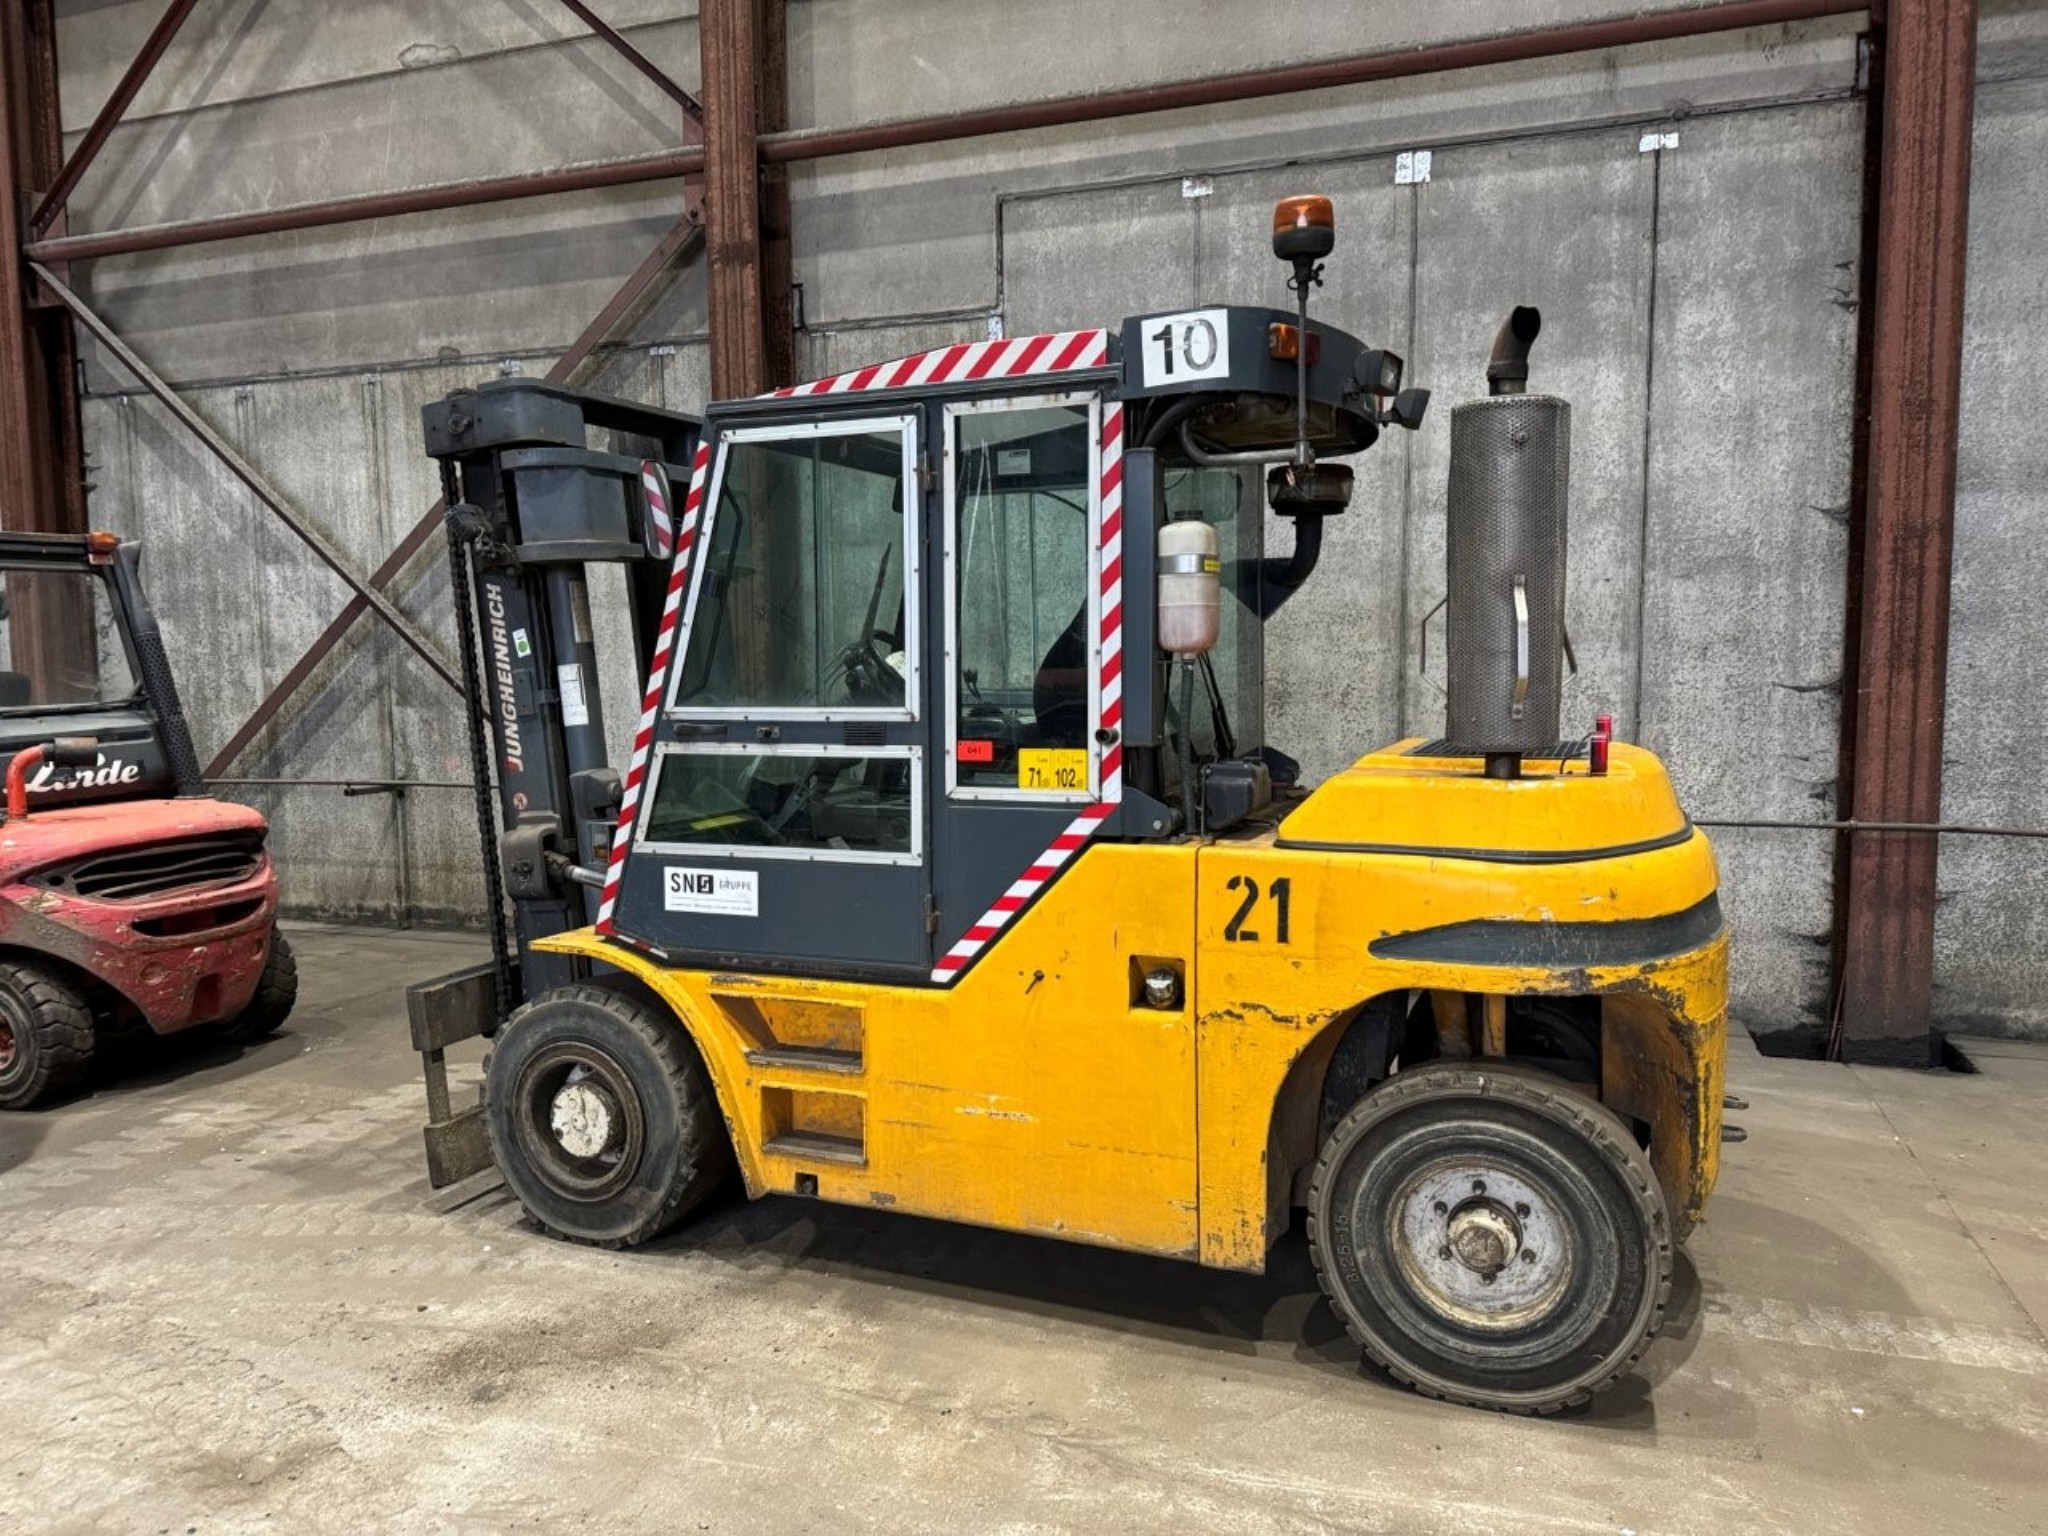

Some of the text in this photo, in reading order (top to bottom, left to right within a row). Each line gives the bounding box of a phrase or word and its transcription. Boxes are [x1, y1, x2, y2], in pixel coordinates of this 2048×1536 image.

[1152, 318, 1218, 375] 10
[485, 582, 524, 773] JUNGHEINRICH
[1028, 767, 1041, 787] 71
[1055, 768, 1076, 788] 102
[1224, 875, 1290, 944] 21
